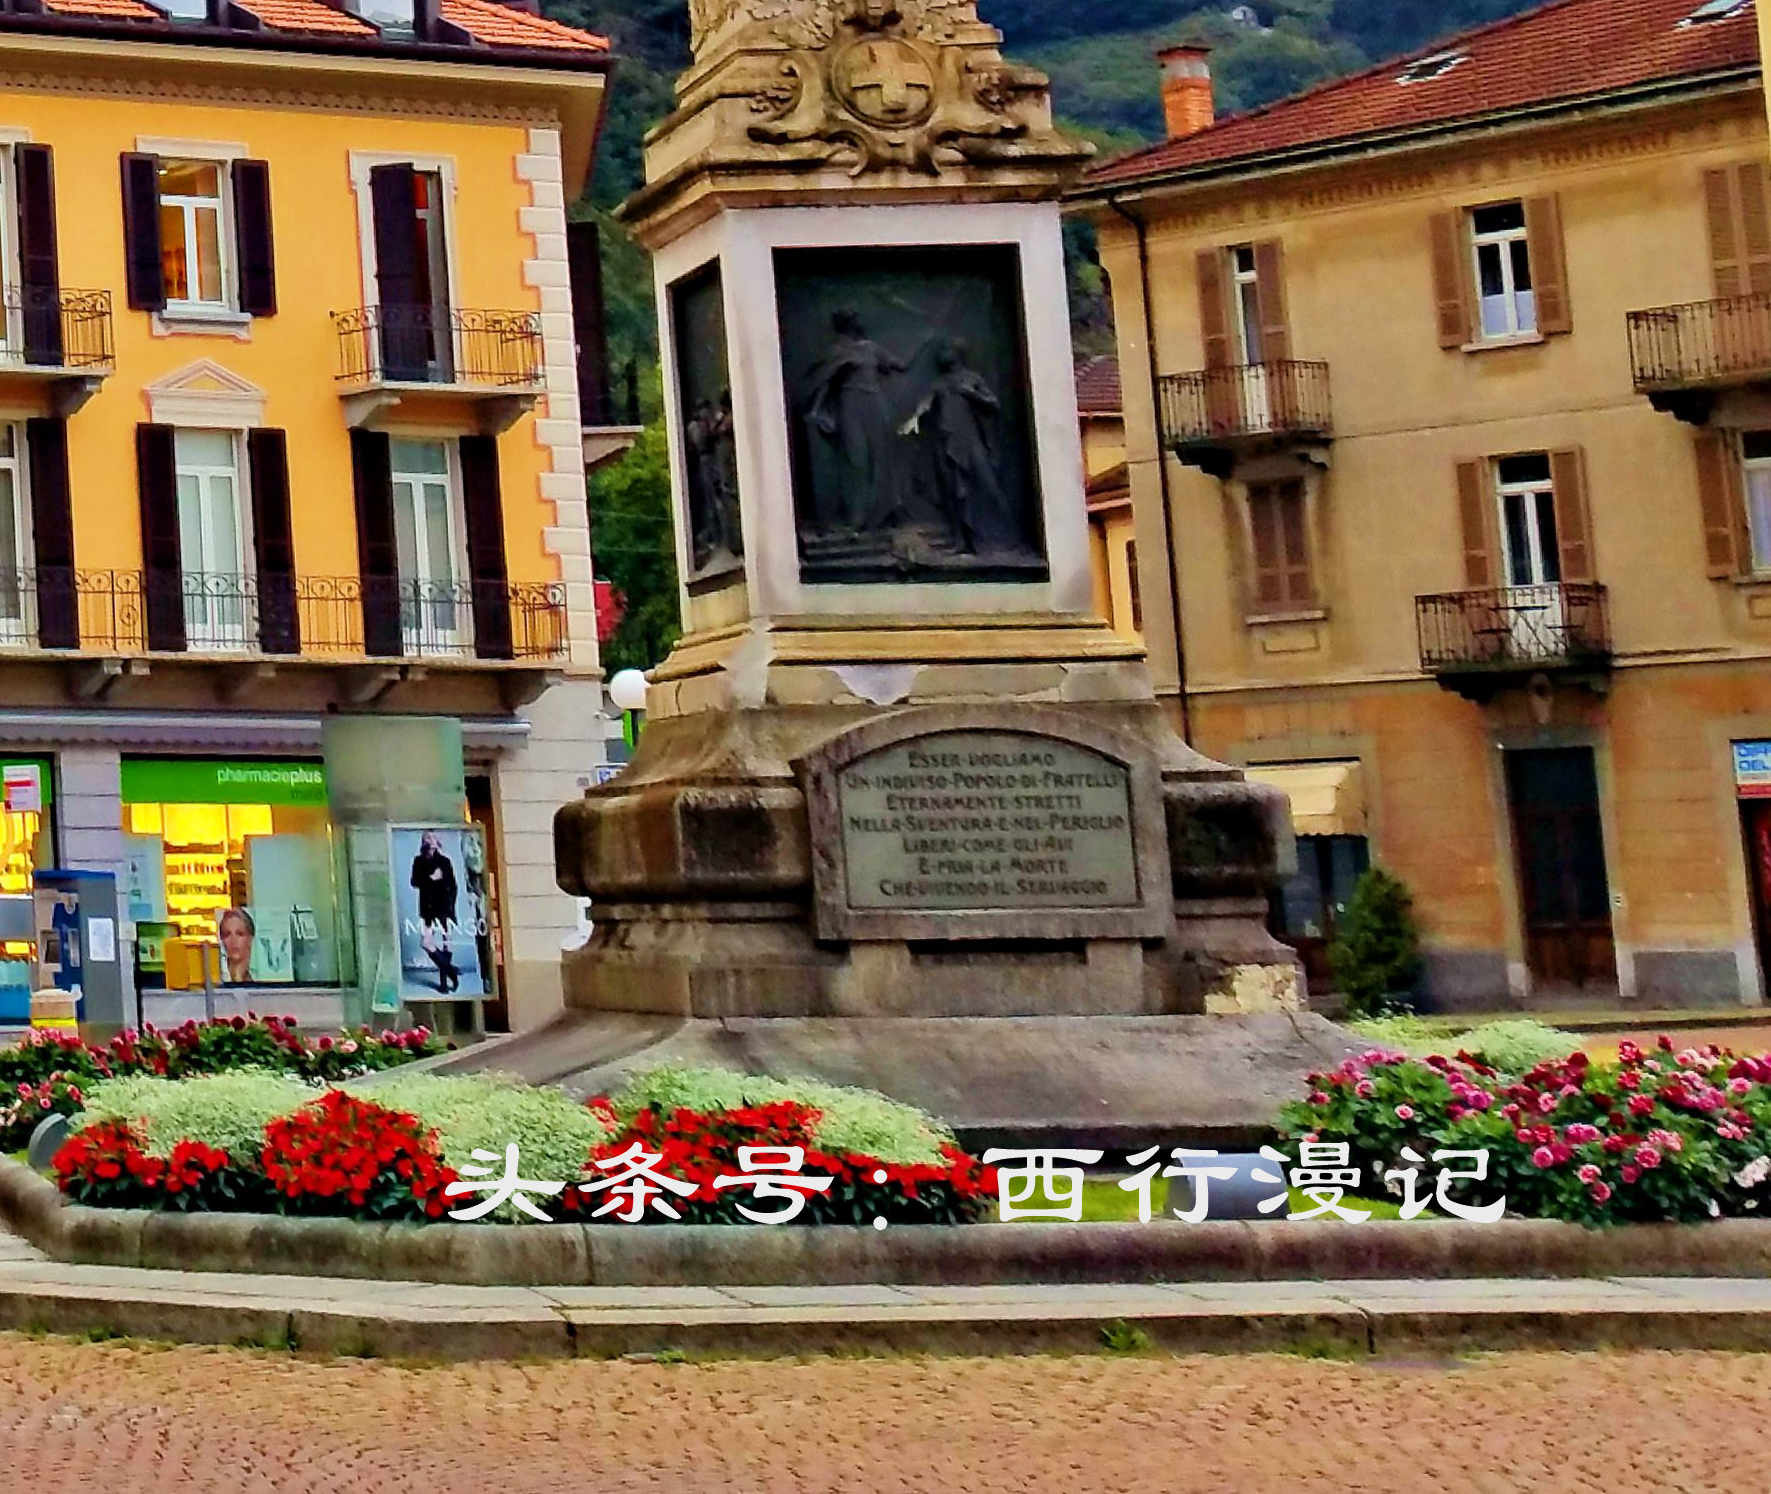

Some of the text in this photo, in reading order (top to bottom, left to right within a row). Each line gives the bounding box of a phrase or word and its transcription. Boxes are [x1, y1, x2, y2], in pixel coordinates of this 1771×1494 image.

[909, 751, 961, 768] ESSER
[216, 766, 323, 787] pharmacieplus
[1043, 771, 1119, 789] FRATELLI
[886, 794, 1081, 811] ETERNAMENTE STRETTI
[403, 917, 488, 937] MANGO
